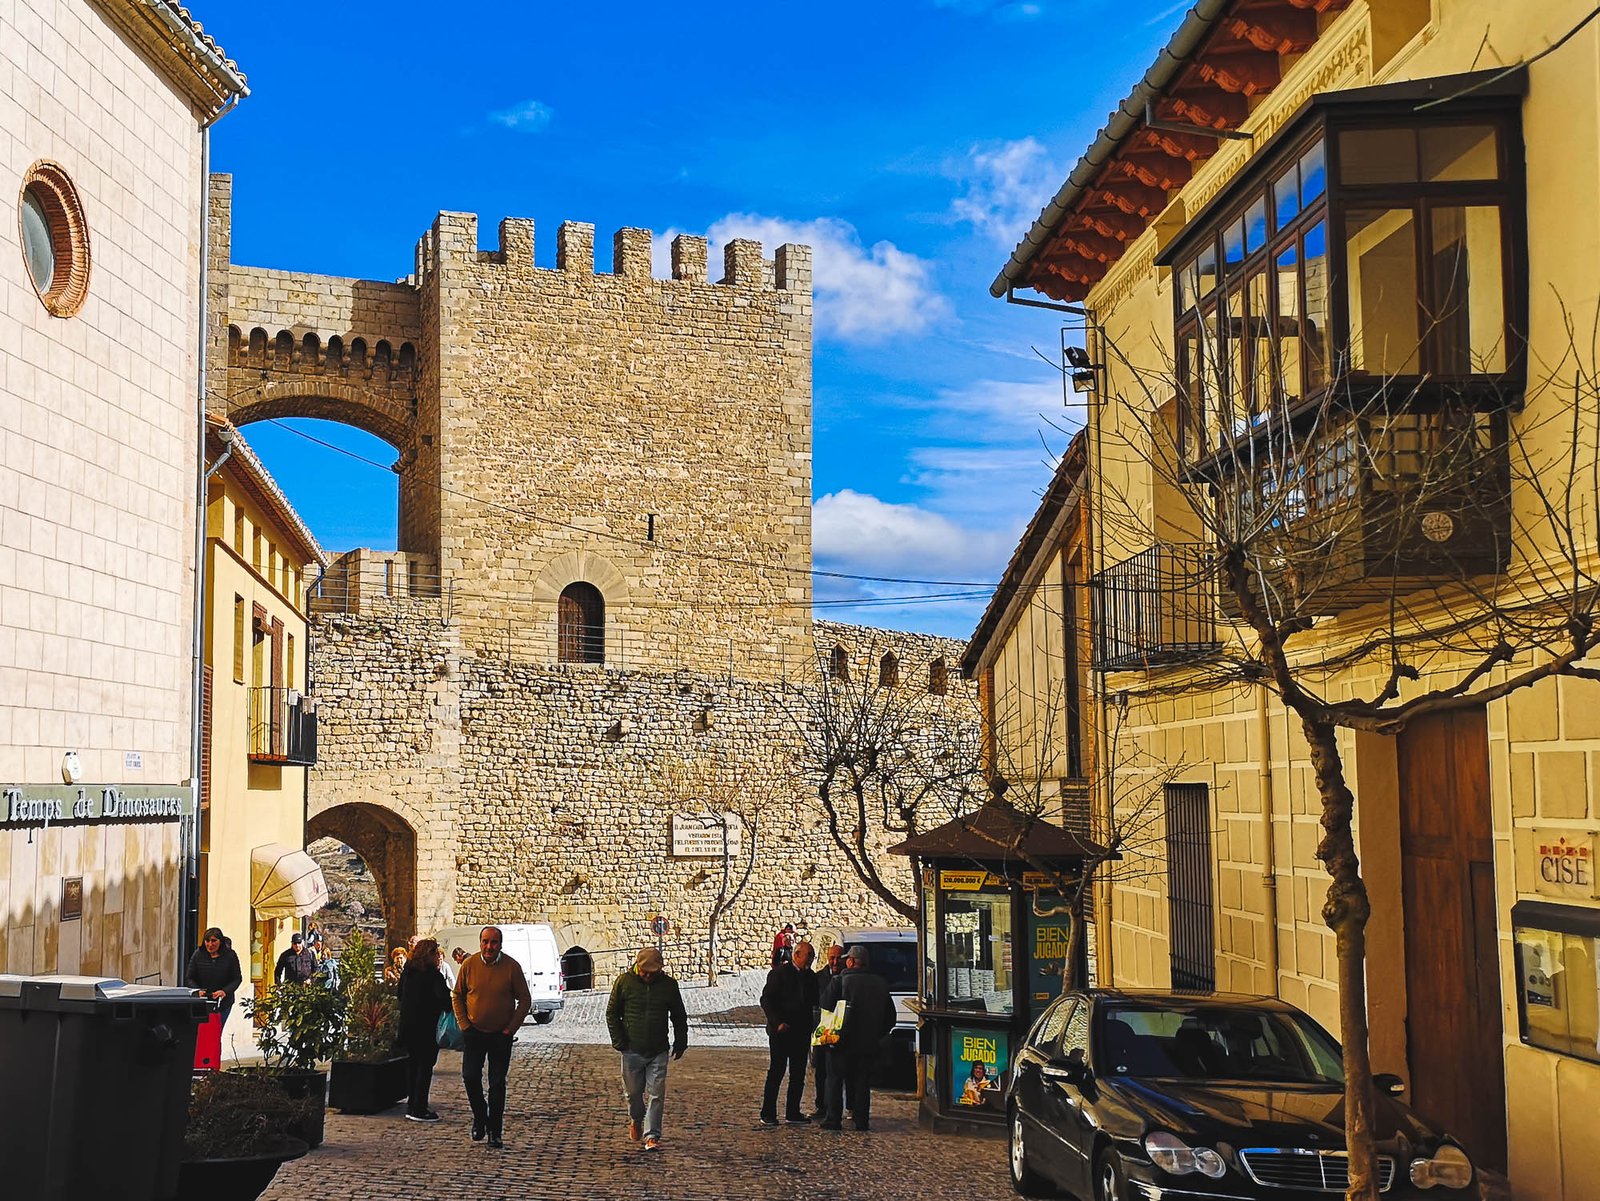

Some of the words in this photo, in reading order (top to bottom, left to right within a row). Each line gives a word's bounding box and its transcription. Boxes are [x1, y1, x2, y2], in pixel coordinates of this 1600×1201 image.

[6, 788, 62, 828] Temps
[74, 787, 94, 818] de
[101, 786, 182, 818] Dinosaures
[1541, 856, 1588, 885] CISE
[1036, 927, 1069, 941] BIEN
[964, 1036, 995, 1050] BIEN
[961, 1049, 995, 1063] JUGADO
